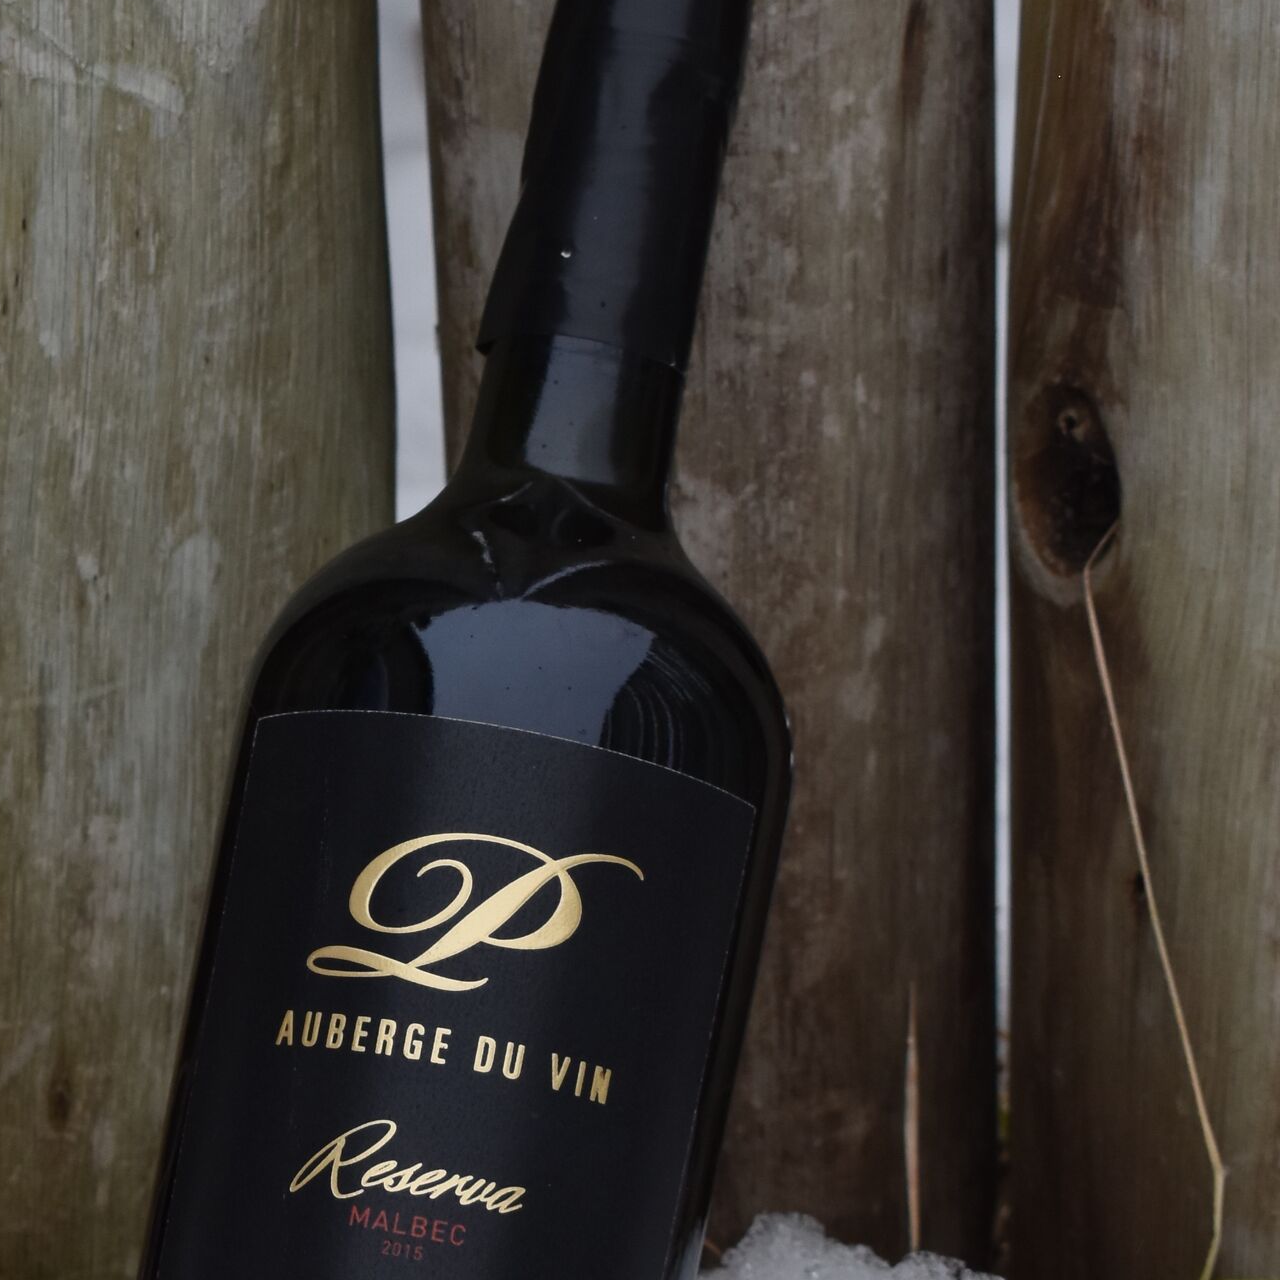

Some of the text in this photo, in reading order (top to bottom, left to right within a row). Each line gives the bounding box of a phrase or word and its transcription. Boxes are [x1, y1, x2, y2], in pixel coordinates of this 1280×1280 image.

[275, 1009, 613, 1105] AUBERGE DU VIN
[289, 1119, 527, 1214] Reserva
[349, 1205, 468, 1246] MALBEC
[381, 1240, 424, 1261] 2015
